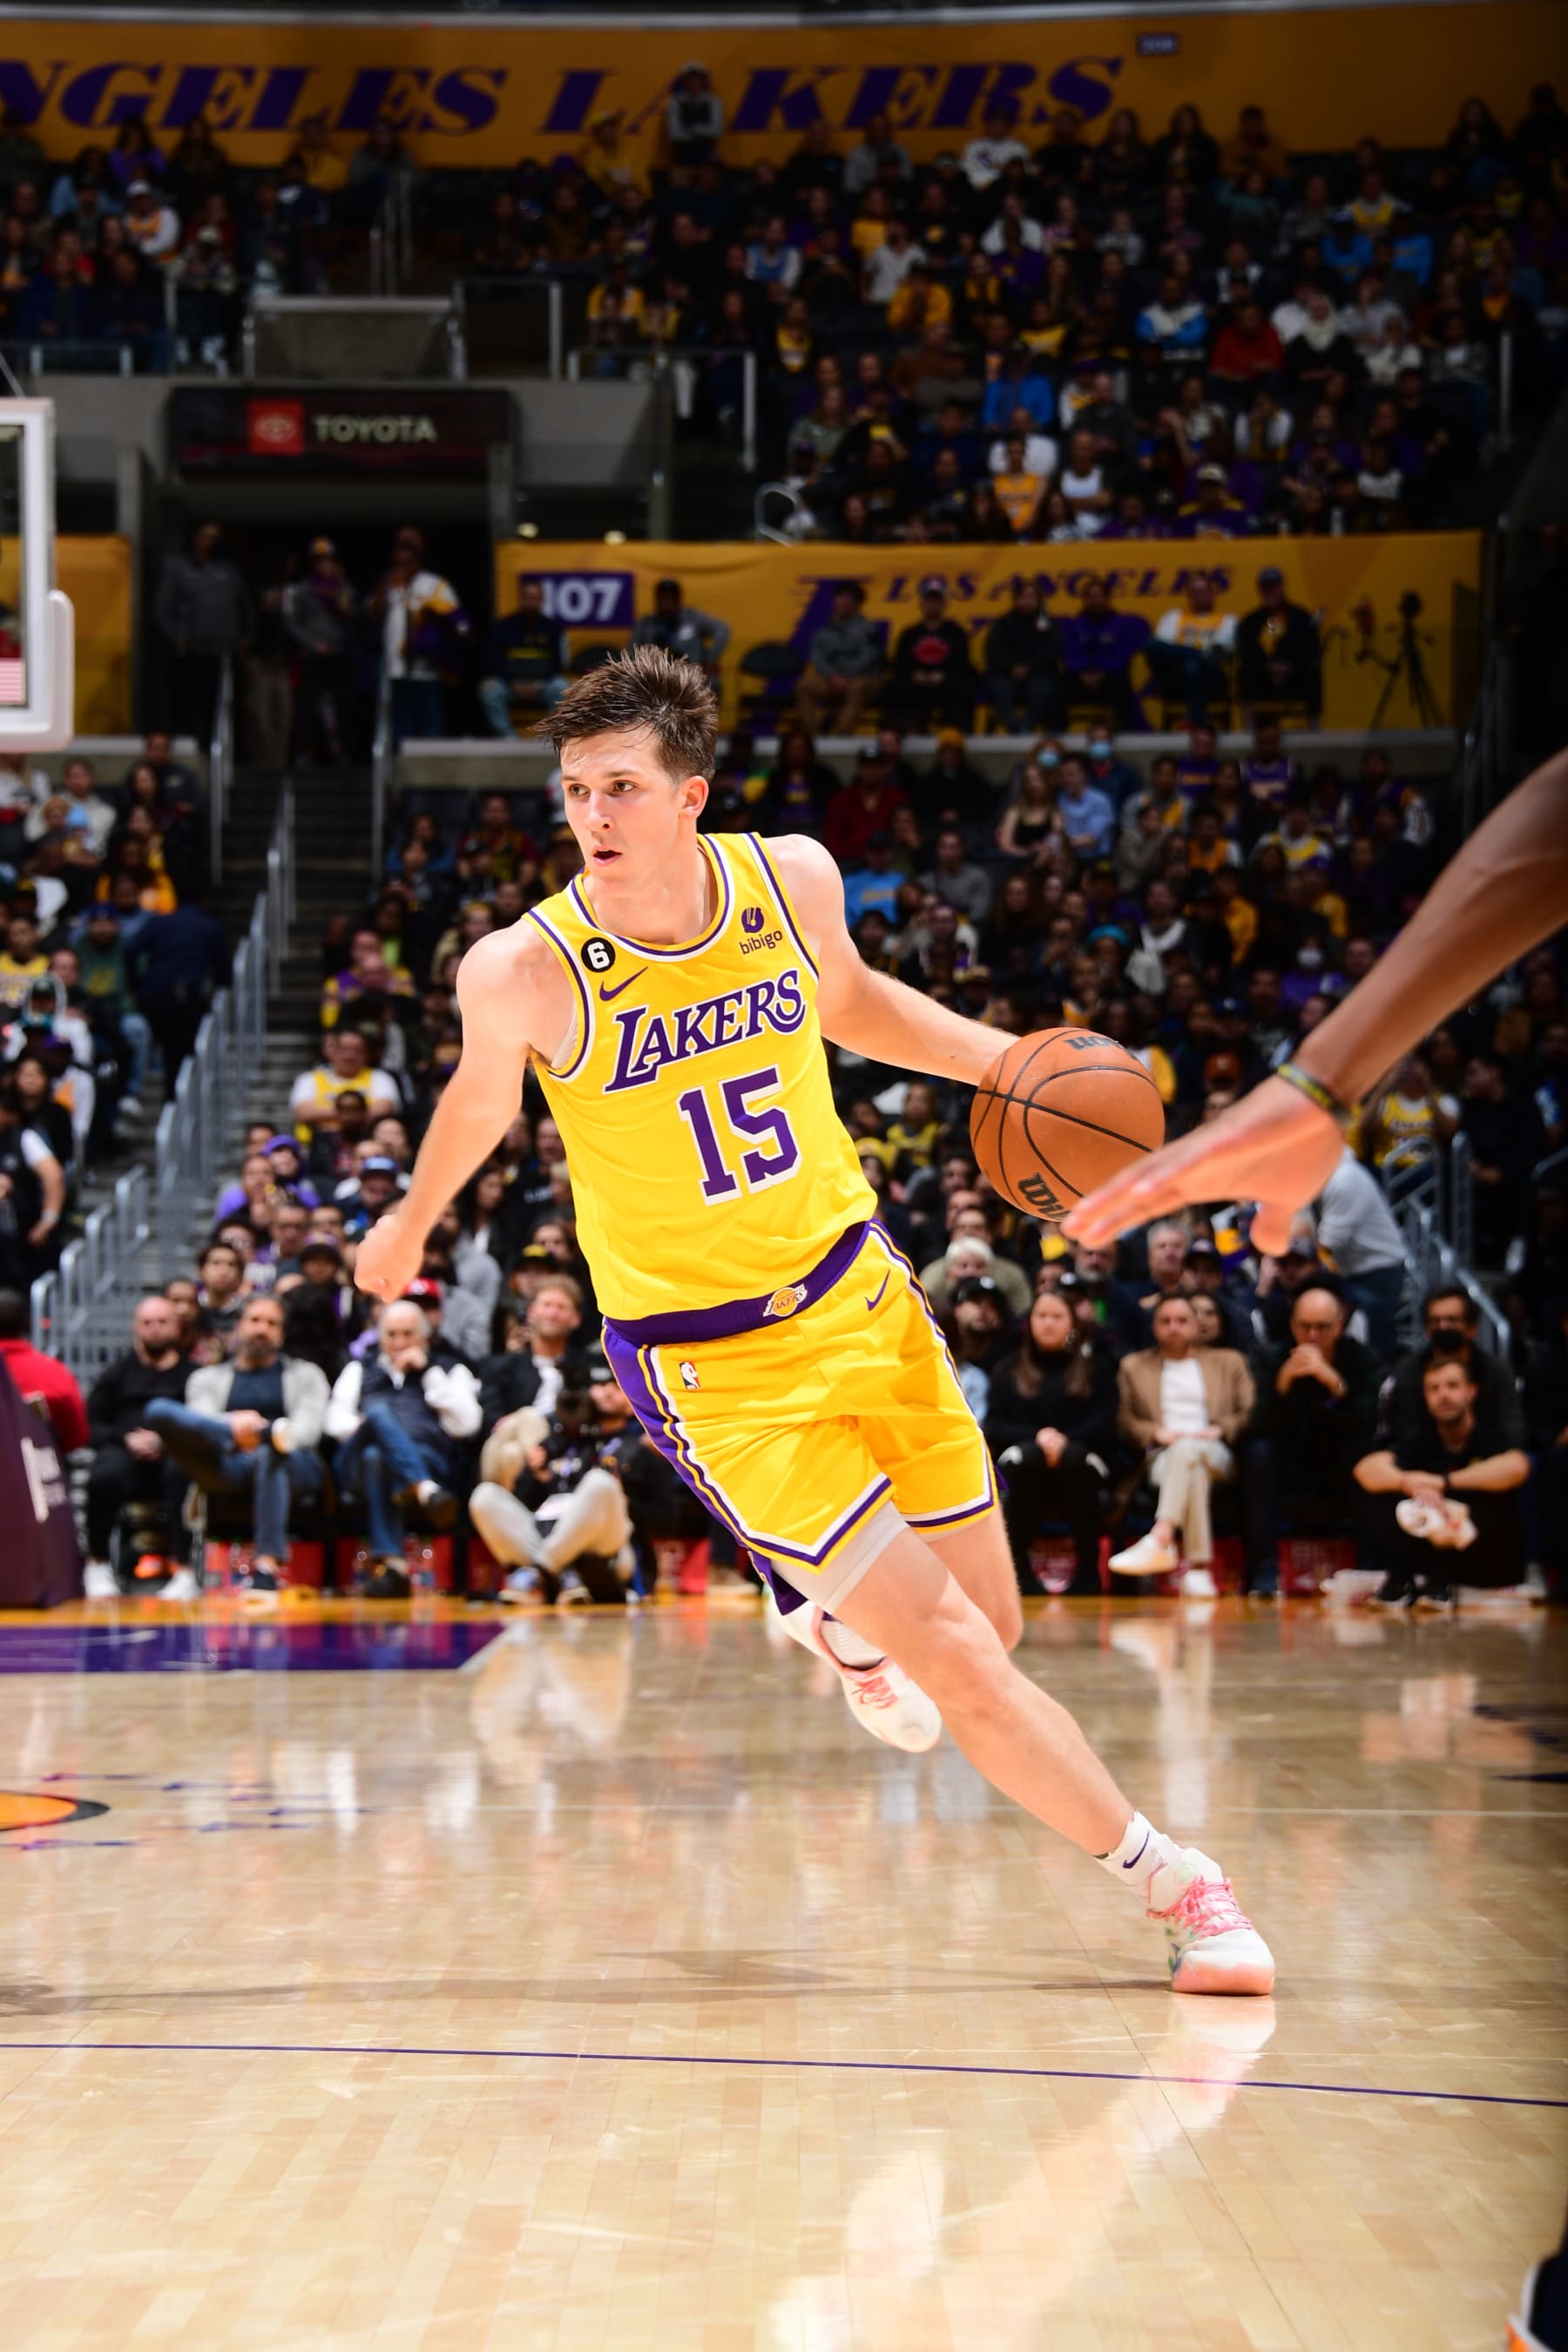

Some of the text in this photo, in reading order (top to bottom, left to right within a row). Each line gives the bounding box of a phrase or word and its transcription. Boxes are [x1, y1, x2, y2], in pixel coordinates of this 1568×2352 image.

[537, 57, 1122, 135] LKERS
[311, 414, 439, 443] TOYOTA
[539, 576, 625, 623] 107
[586, 941, 611, 970] 6
[739, 929, 783, 956] bibigo
[604, 969, 806, 1093] LAKERS
[678, 1064, 802, 1206] 15
[1017, 1172, 1071, 1220] Wil
